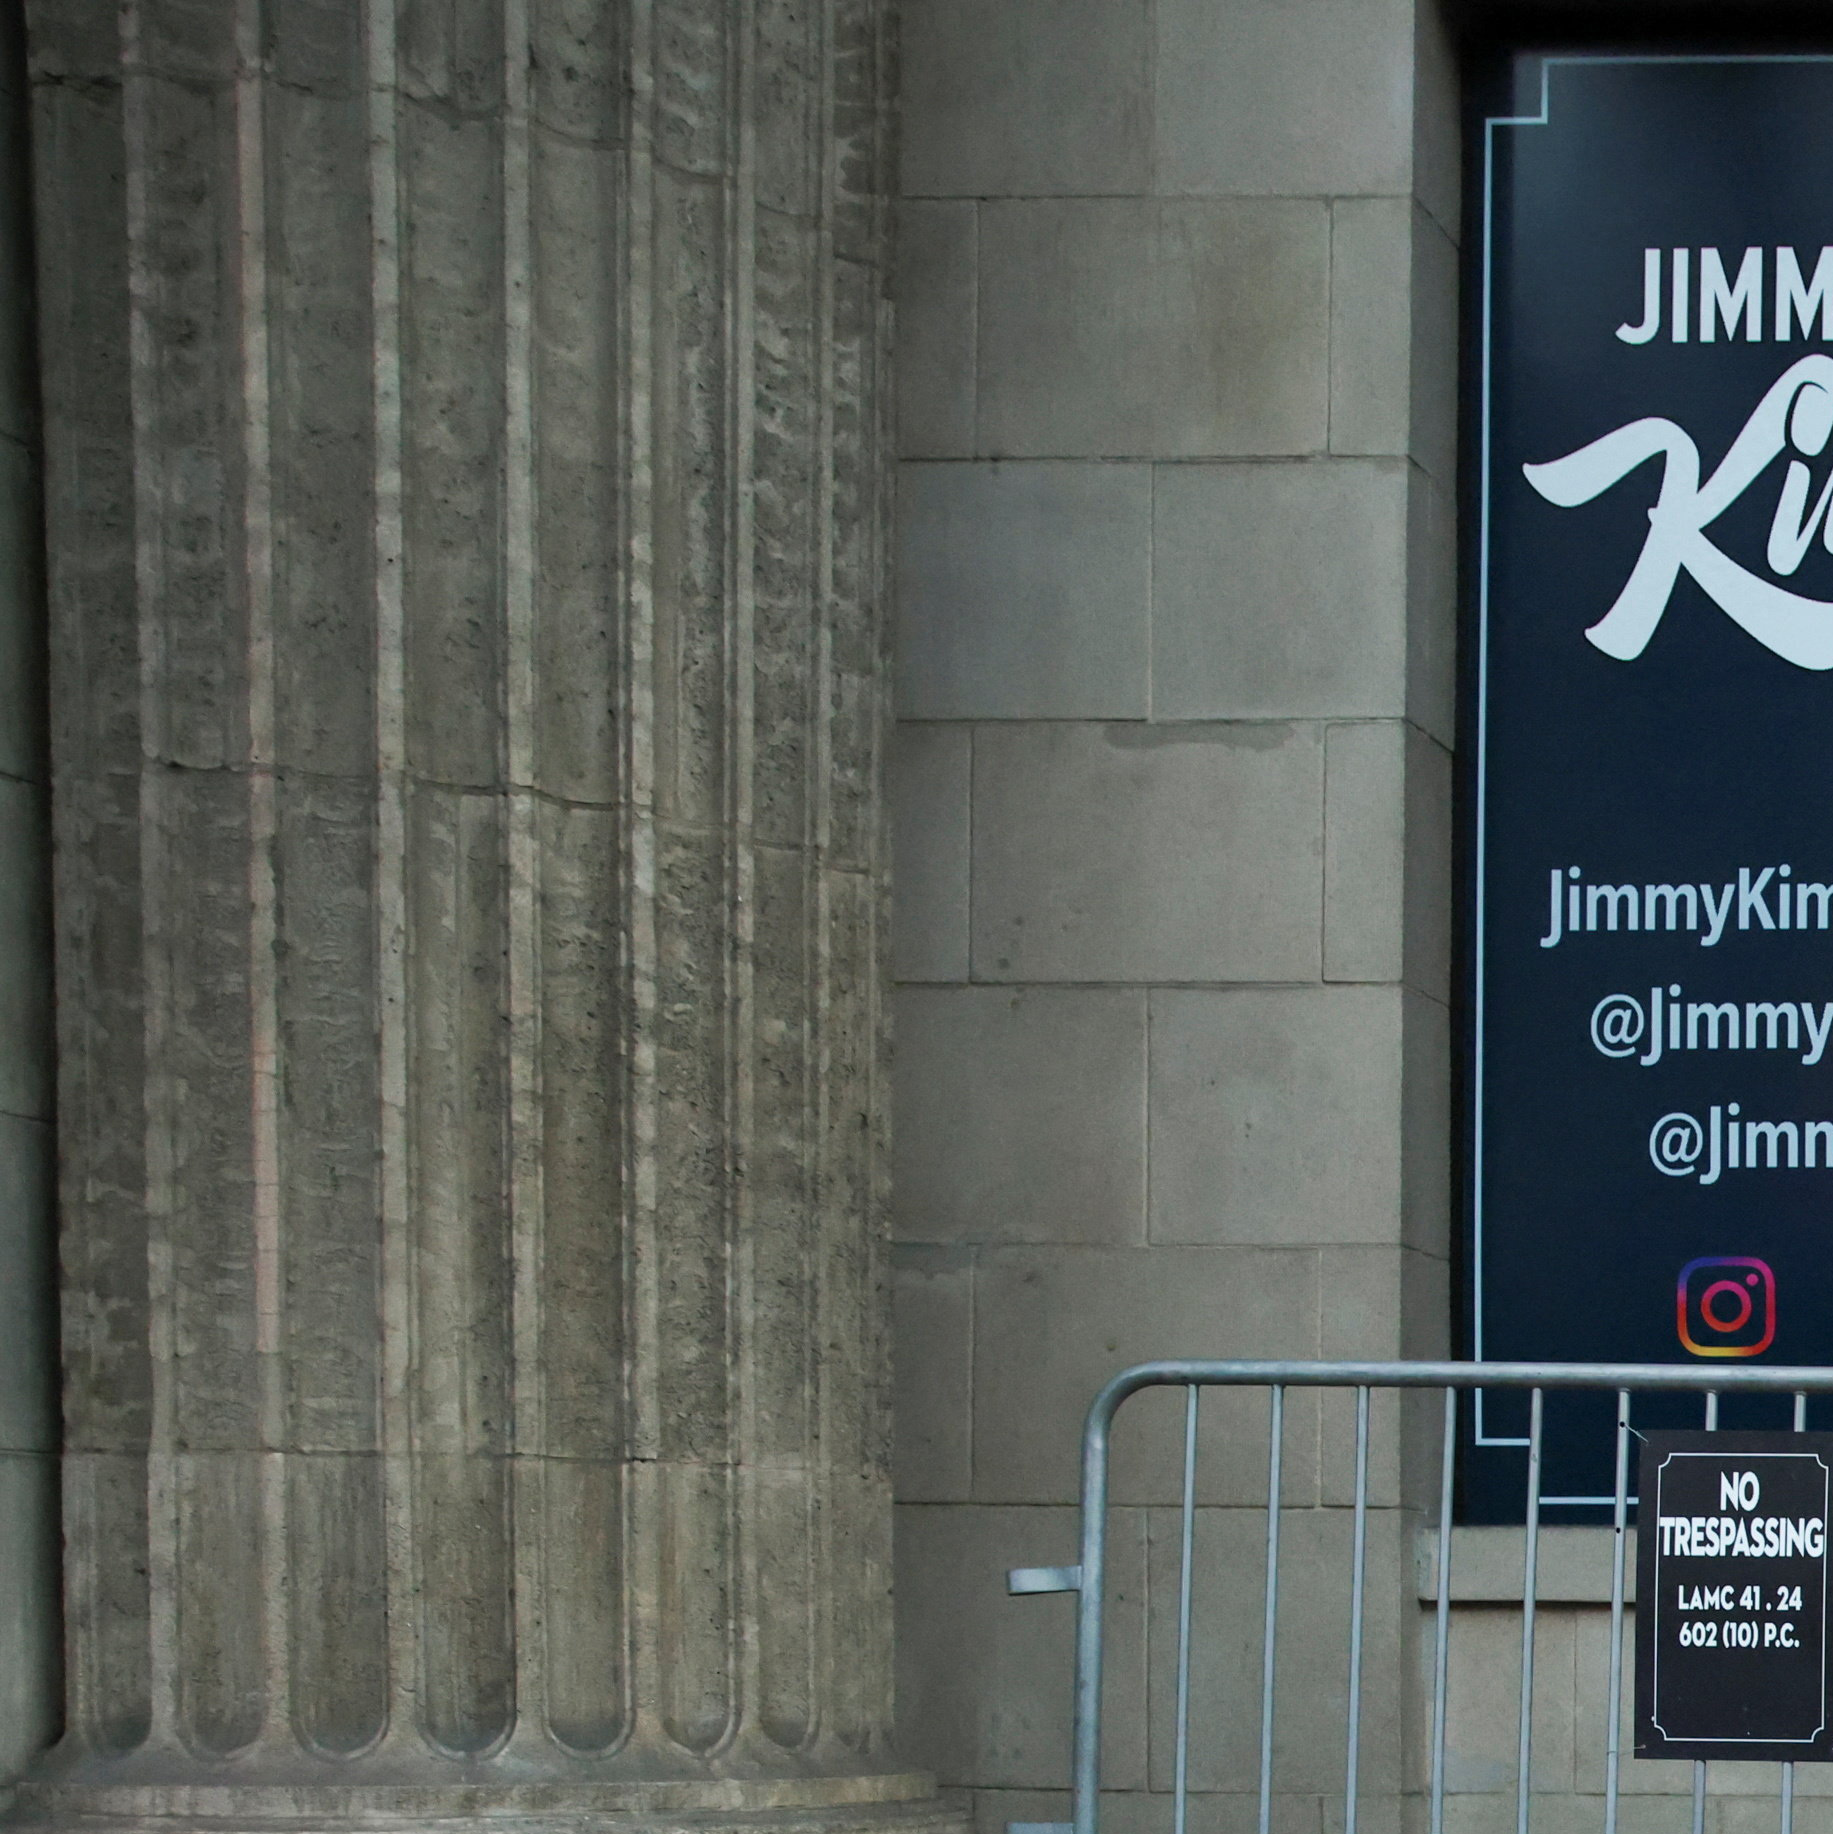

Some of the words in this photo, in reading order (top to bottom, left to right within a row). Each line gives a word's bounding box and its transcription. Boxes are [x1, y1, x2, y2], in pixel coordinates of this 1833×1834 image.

[1721, 1472, 1759, 1511] NO
[1659, 1516, 1824, 1558] TRESPASSING
[1679, 1585, 1734, 1610] LAMC
[1740, 1586, 1760, 1610] 41
[1777, 1586, 1802, 1610] 24
[1680, 1622, 1717, 1646] 602
[1723, 1621, 1758, 1648] (10)
[1765, 1623, 1799, 1647] P.C.
